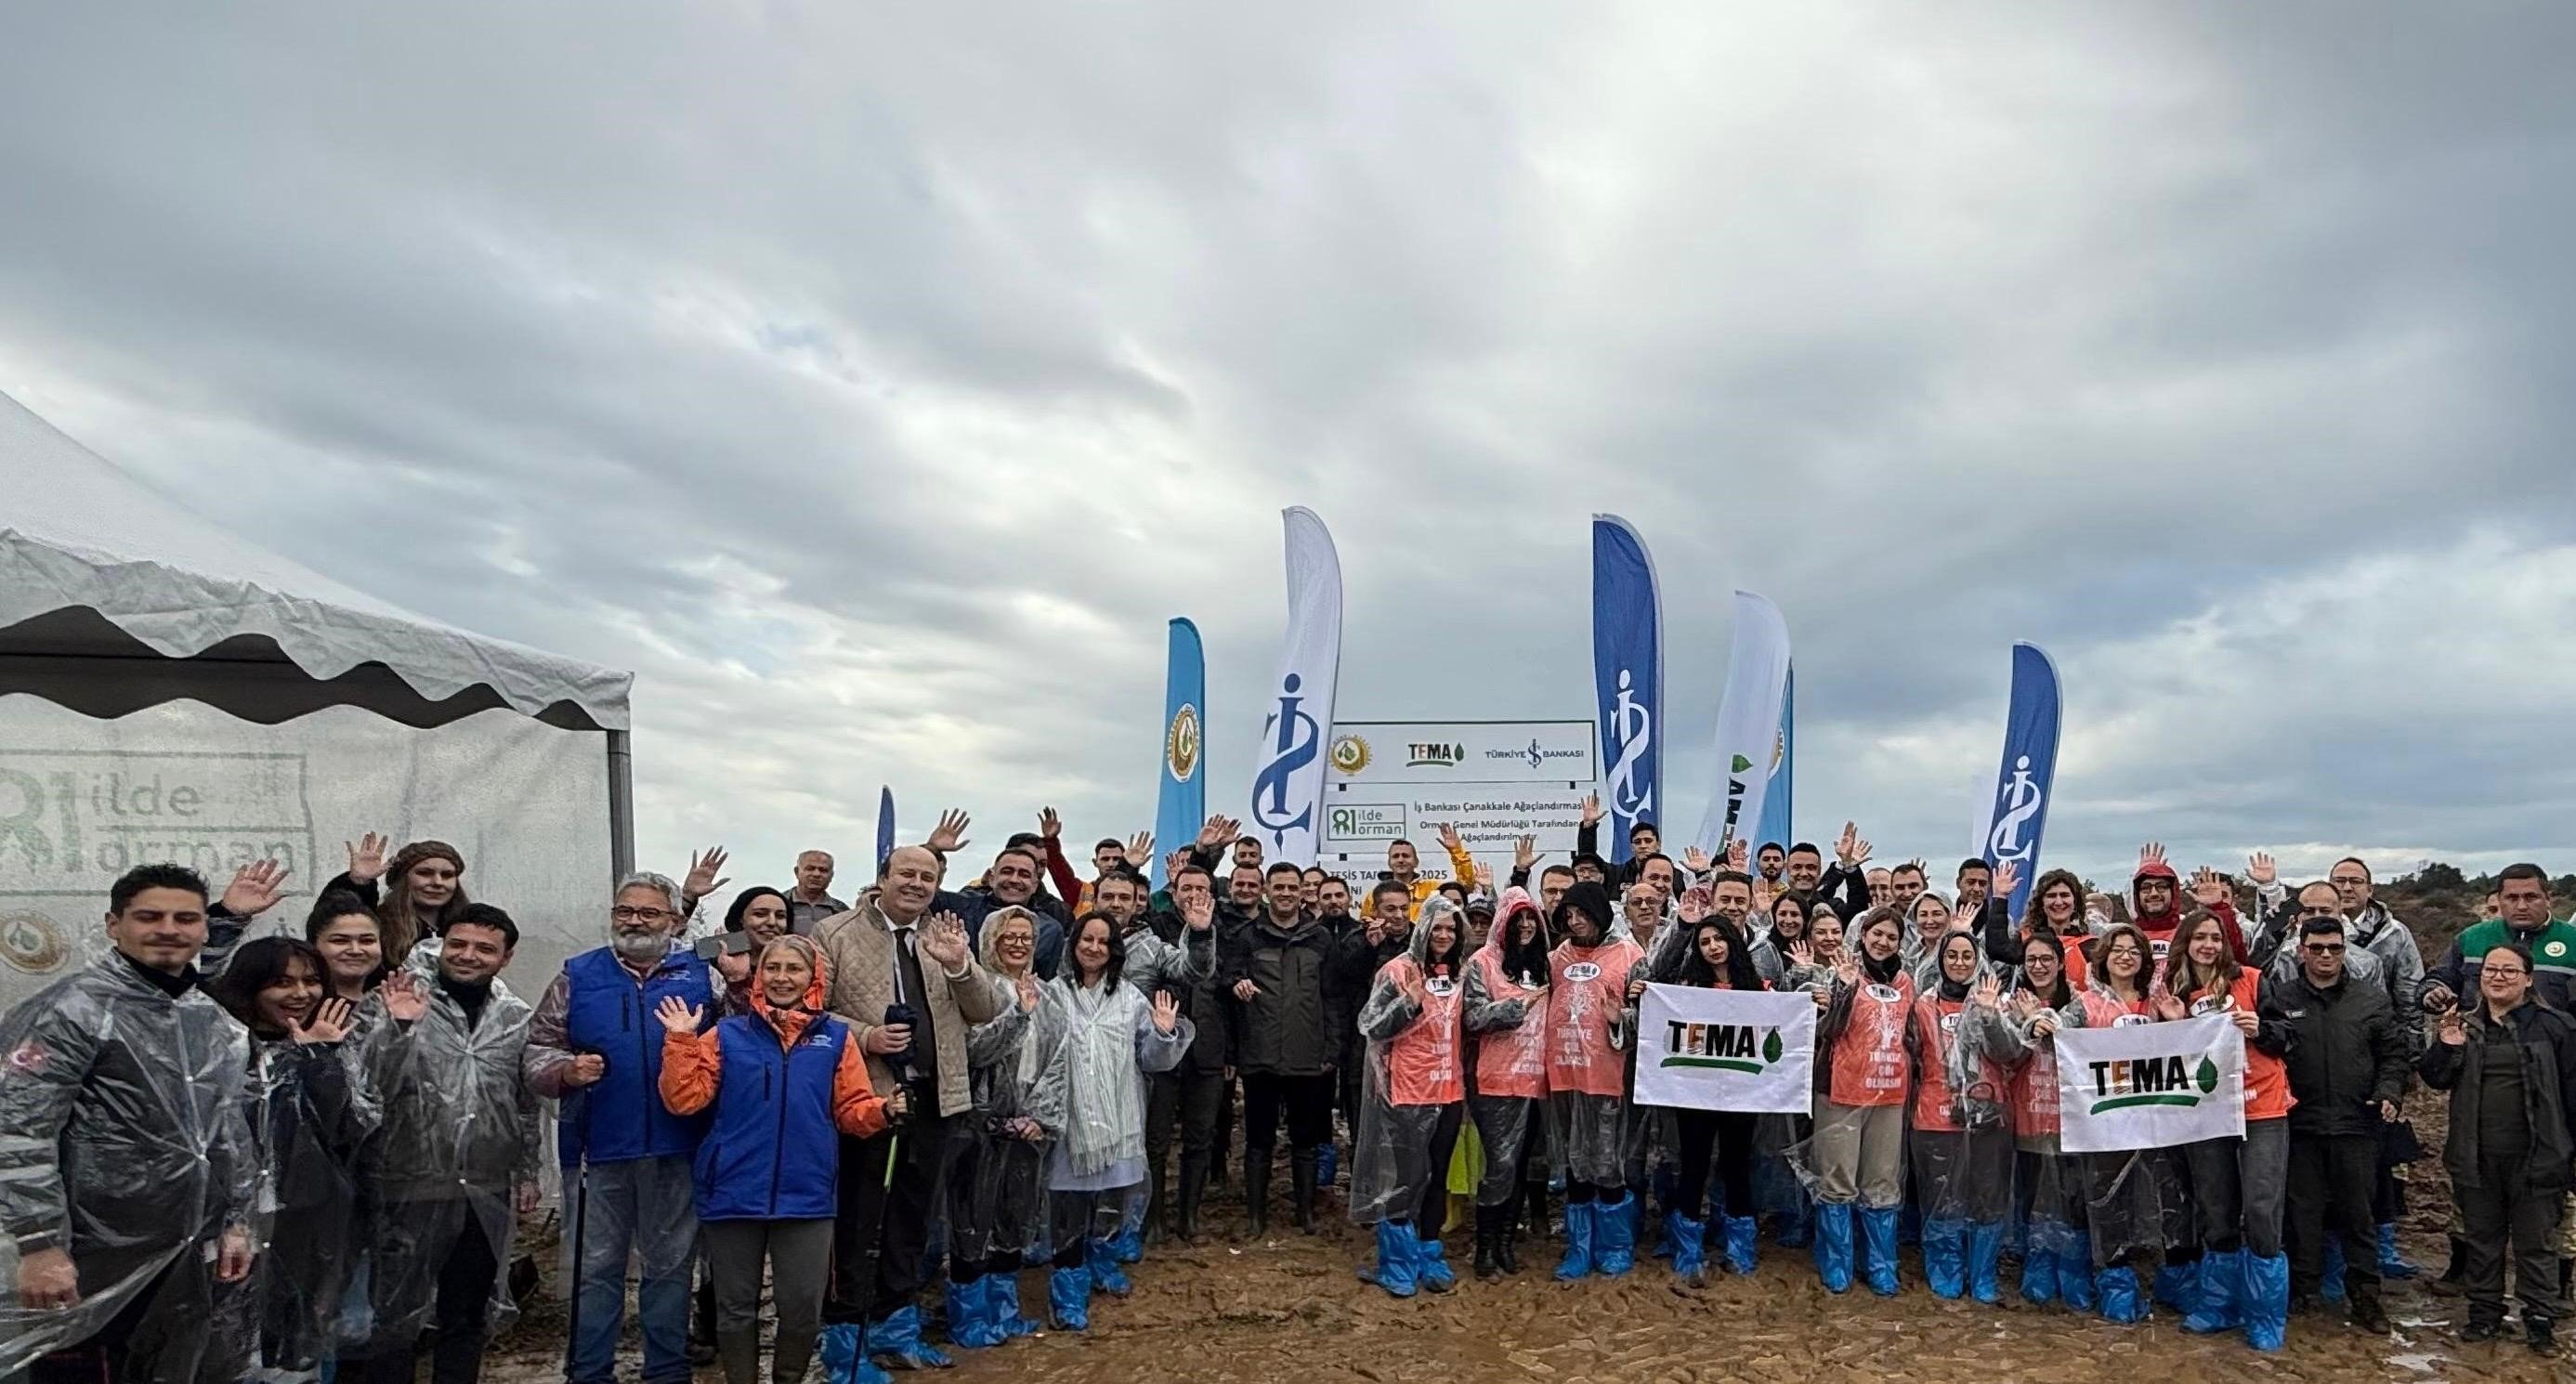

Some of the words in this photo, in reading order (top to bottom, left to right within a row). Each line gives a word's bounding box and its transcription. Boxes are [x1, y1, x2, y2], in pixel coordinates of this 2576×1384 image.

[1408, 743, 1452, 760] TEMA
[1485, 750, 1526, 758] TÜRKİYE
[93, 773, 200, 817] ilde
[1414, 801, 1422, 814] İş
[1424, 803, 1460, 812] Bankası
[1463, 802, 1511, 813] Çanakkale
[1513, 802, 1582, 813] Ağaçlandırmas
[1358, 810, 1382, 821] ilde
[1453, 820, 1478, 829] Genel
[1481, 819, 1530, 829] Müdürlüğü
[1358, 826, 1402, 835] orman
[1421, 870, 1447, 879] 2025
[1667, 1020, 1756, 1057] TEMA
[2089, 1055, 2190, 1096] TEMA
